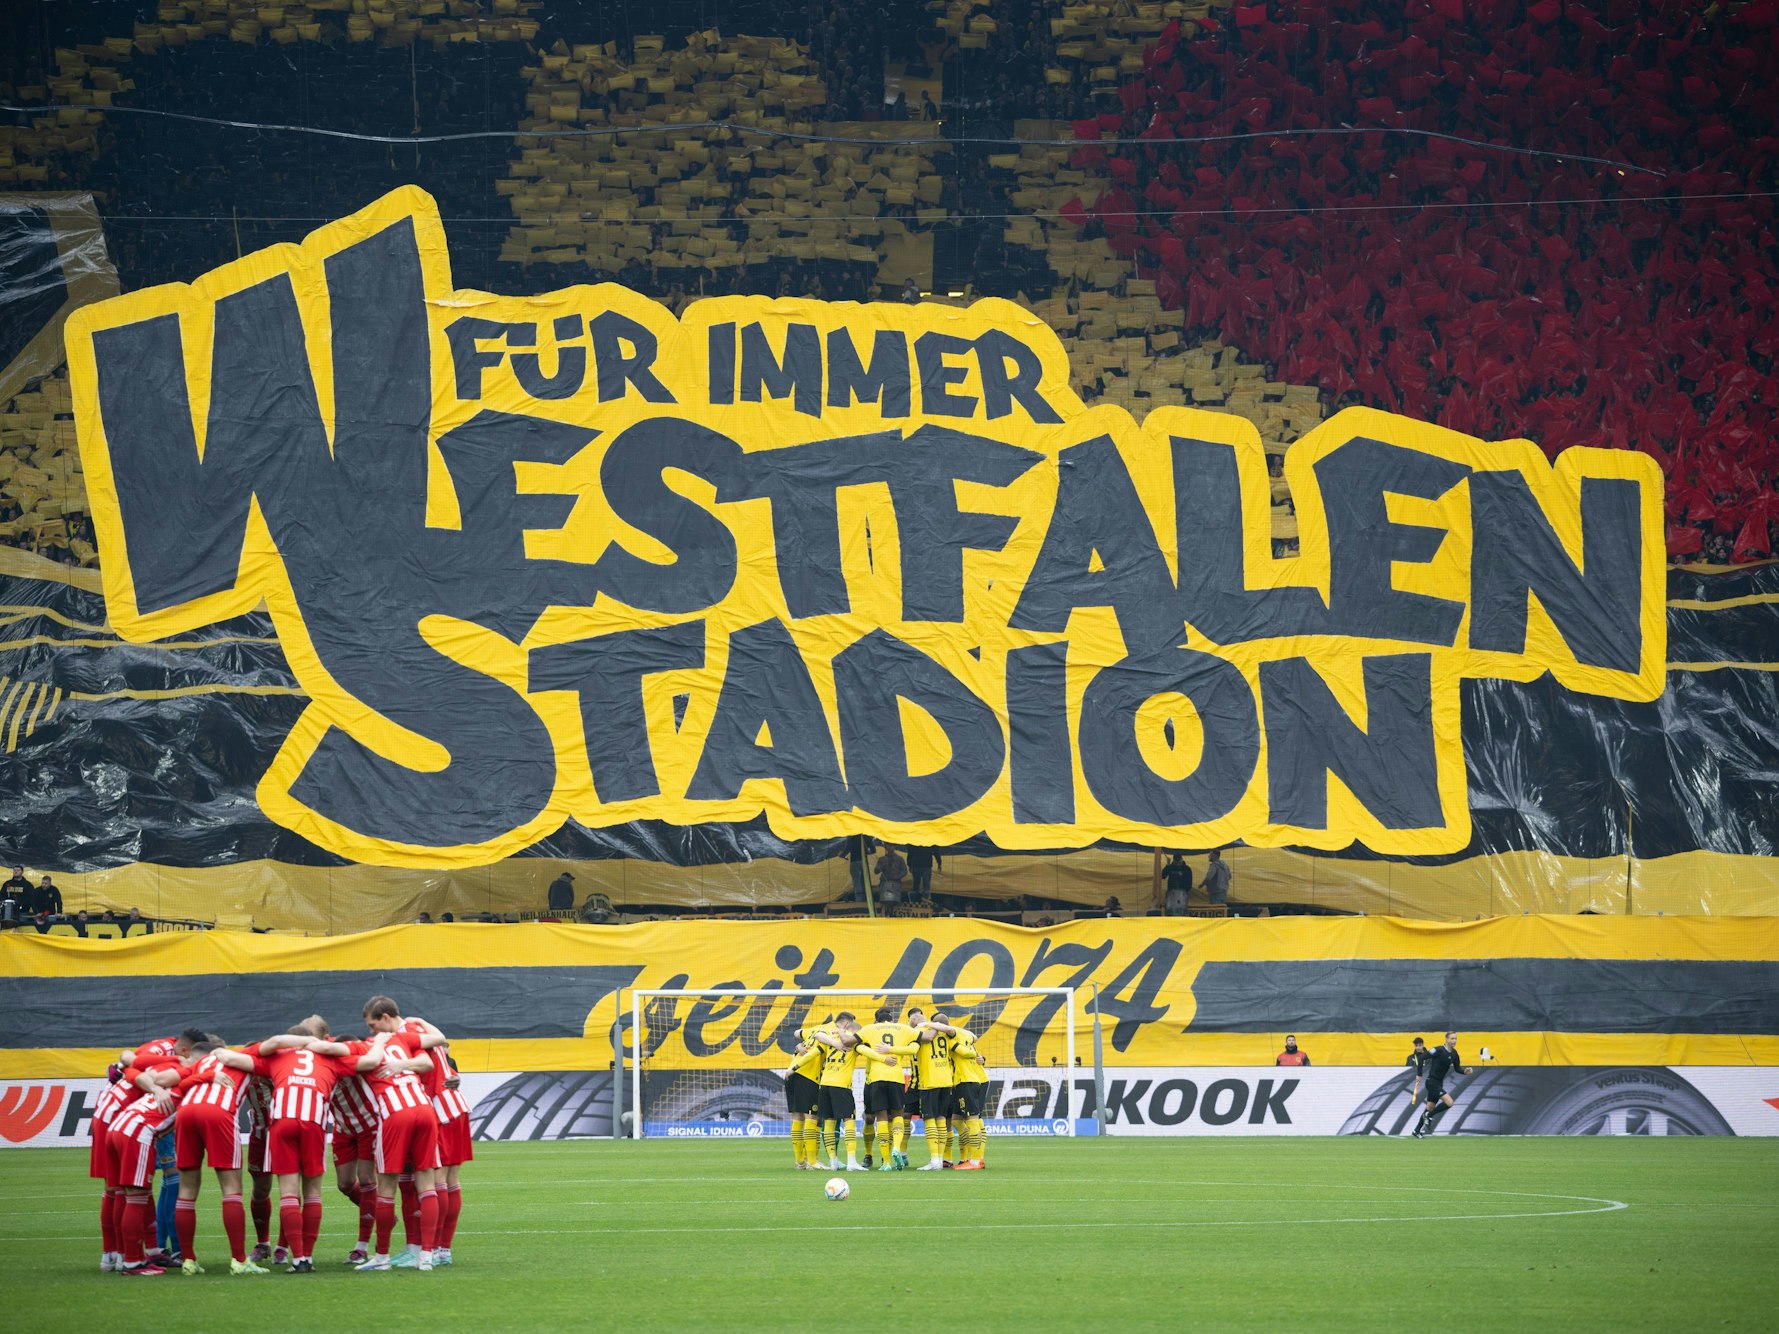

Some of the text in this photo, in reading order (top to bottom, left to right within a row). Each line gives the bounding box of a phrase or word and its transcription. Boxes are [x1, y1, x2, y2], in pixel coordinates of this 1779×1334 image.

[445, 309, 1061, 424] FÜR IMMER
[92, 214, 1643, 675] WESTFALEN
[287, 600, 1447, 847] STADION
[609, 937, 1184, 1067] seit 1974
[931, 1036, 948, 1059] 19
[293, 1050, 314, 1076] 3
[287, 1076, 317, 1087] JAECKEL
[667, 1126, 743, 1136] SIGNAL IDUNA
[1014, 1125, 1050, 1134] IDUNA
